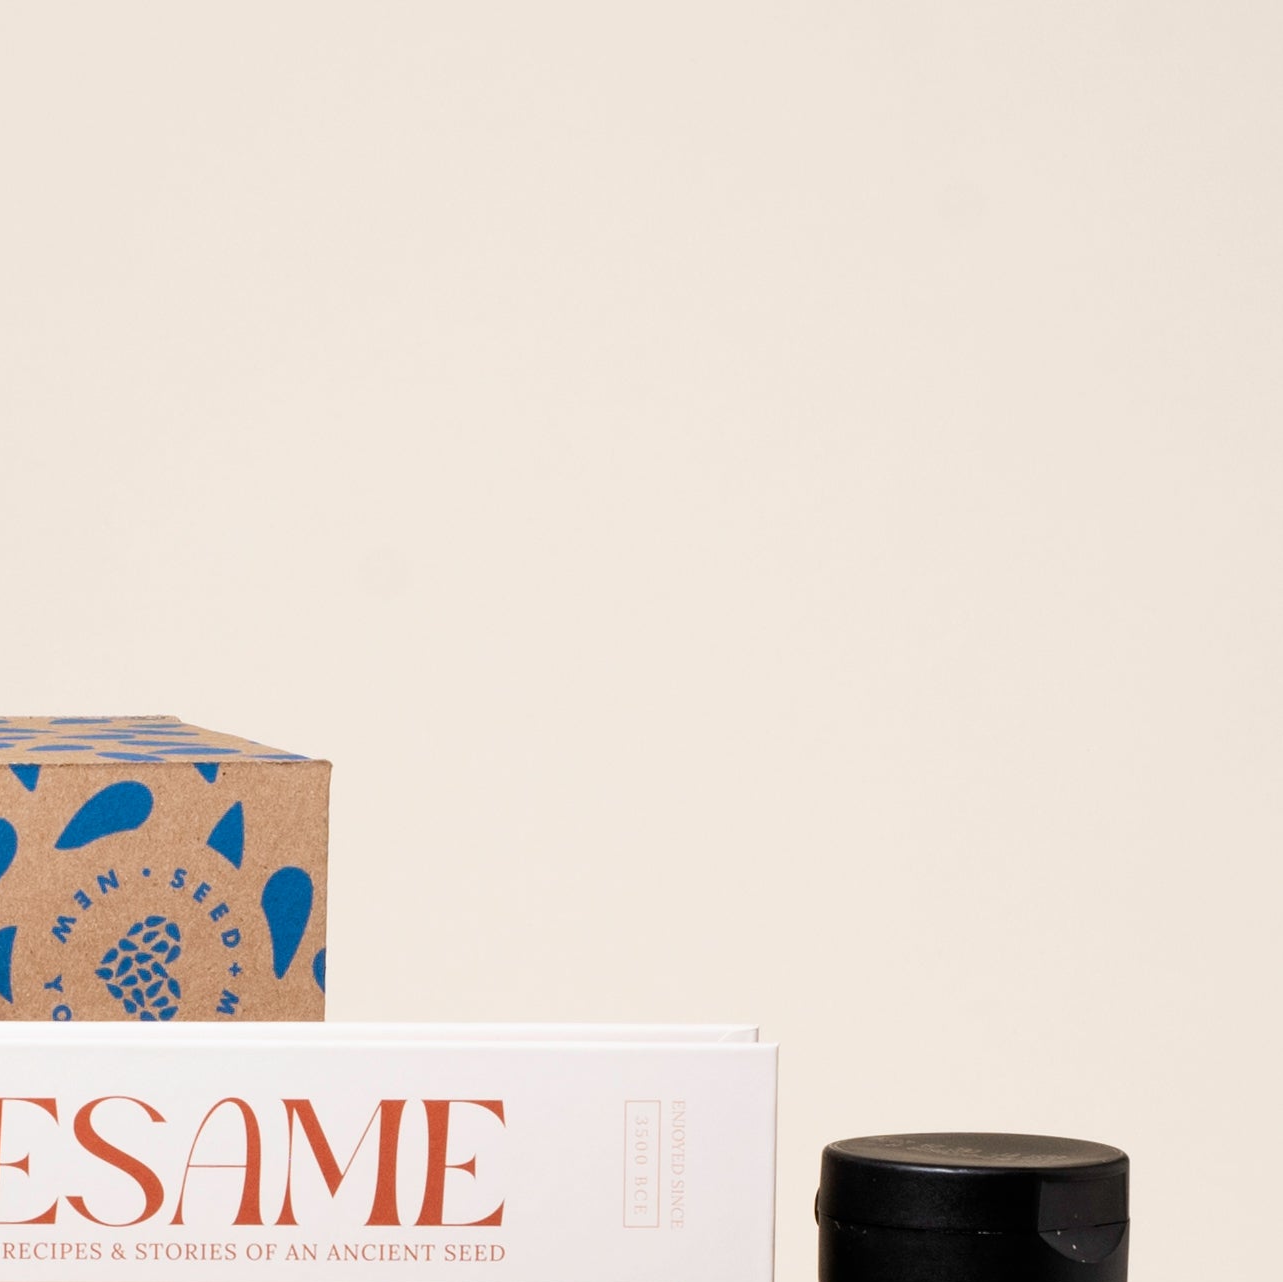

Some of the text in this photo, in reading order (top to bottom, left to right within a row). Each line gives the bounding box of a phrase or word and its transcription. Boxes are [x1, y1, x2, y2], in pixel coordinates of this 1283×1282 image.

[50, 868, 120, 945] NEW
[170, 868, 242, 949] SEED
[632, 1113, 649, 1216] 3500 BCE
[670, 1099, 687, 1231] ENJOYED SINCE
[2, 1242, 102, 1261] RECIPES
[110, 1242, 127, 1261] &
[135, 1242, 237, 1261] STORIES
[245, 1243, 278, 1261] OF
[285, 1243, 318, 1261] AN
[326, 1243, 436, 1262] ANCIENT
[444, 1244, 506, 1262] SEED
